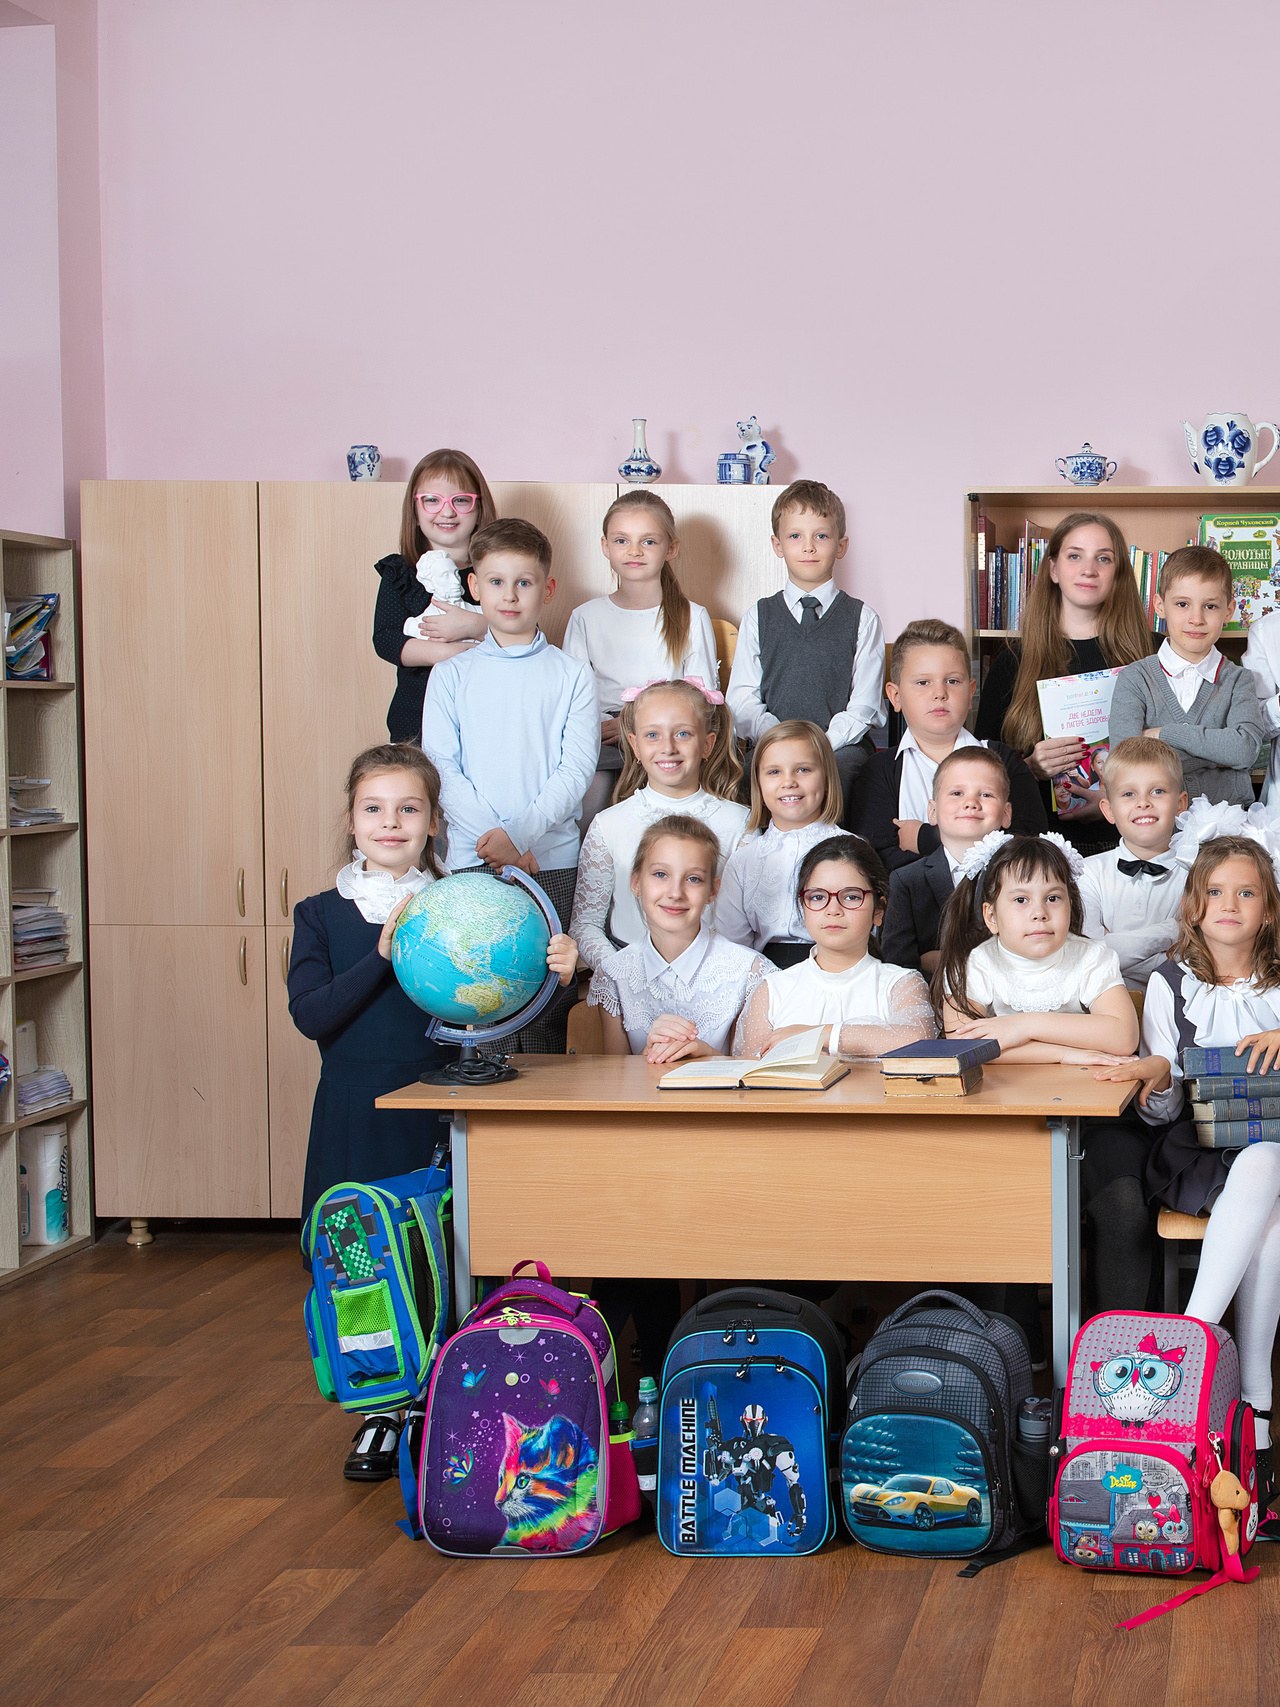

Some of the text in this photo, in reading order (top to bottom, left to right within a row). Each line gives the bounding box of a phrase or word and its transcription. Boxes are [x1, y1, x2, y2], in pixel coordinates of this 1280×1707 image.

[1222, 548, 1271, 561] ЗОЛОТЫЕ
[1227, 561, 1269, 570] ТРАНИЦЫ
[1068, 708, 1103, 721] ДВЕ НЕДЕЛИ
[1066, 719, 1085, 729] ЛАГЕРЕ
[897, 1379, 937, 1389] WINNER ONE
[681, 1398, 697, 1543] BATTLE MACHINE
